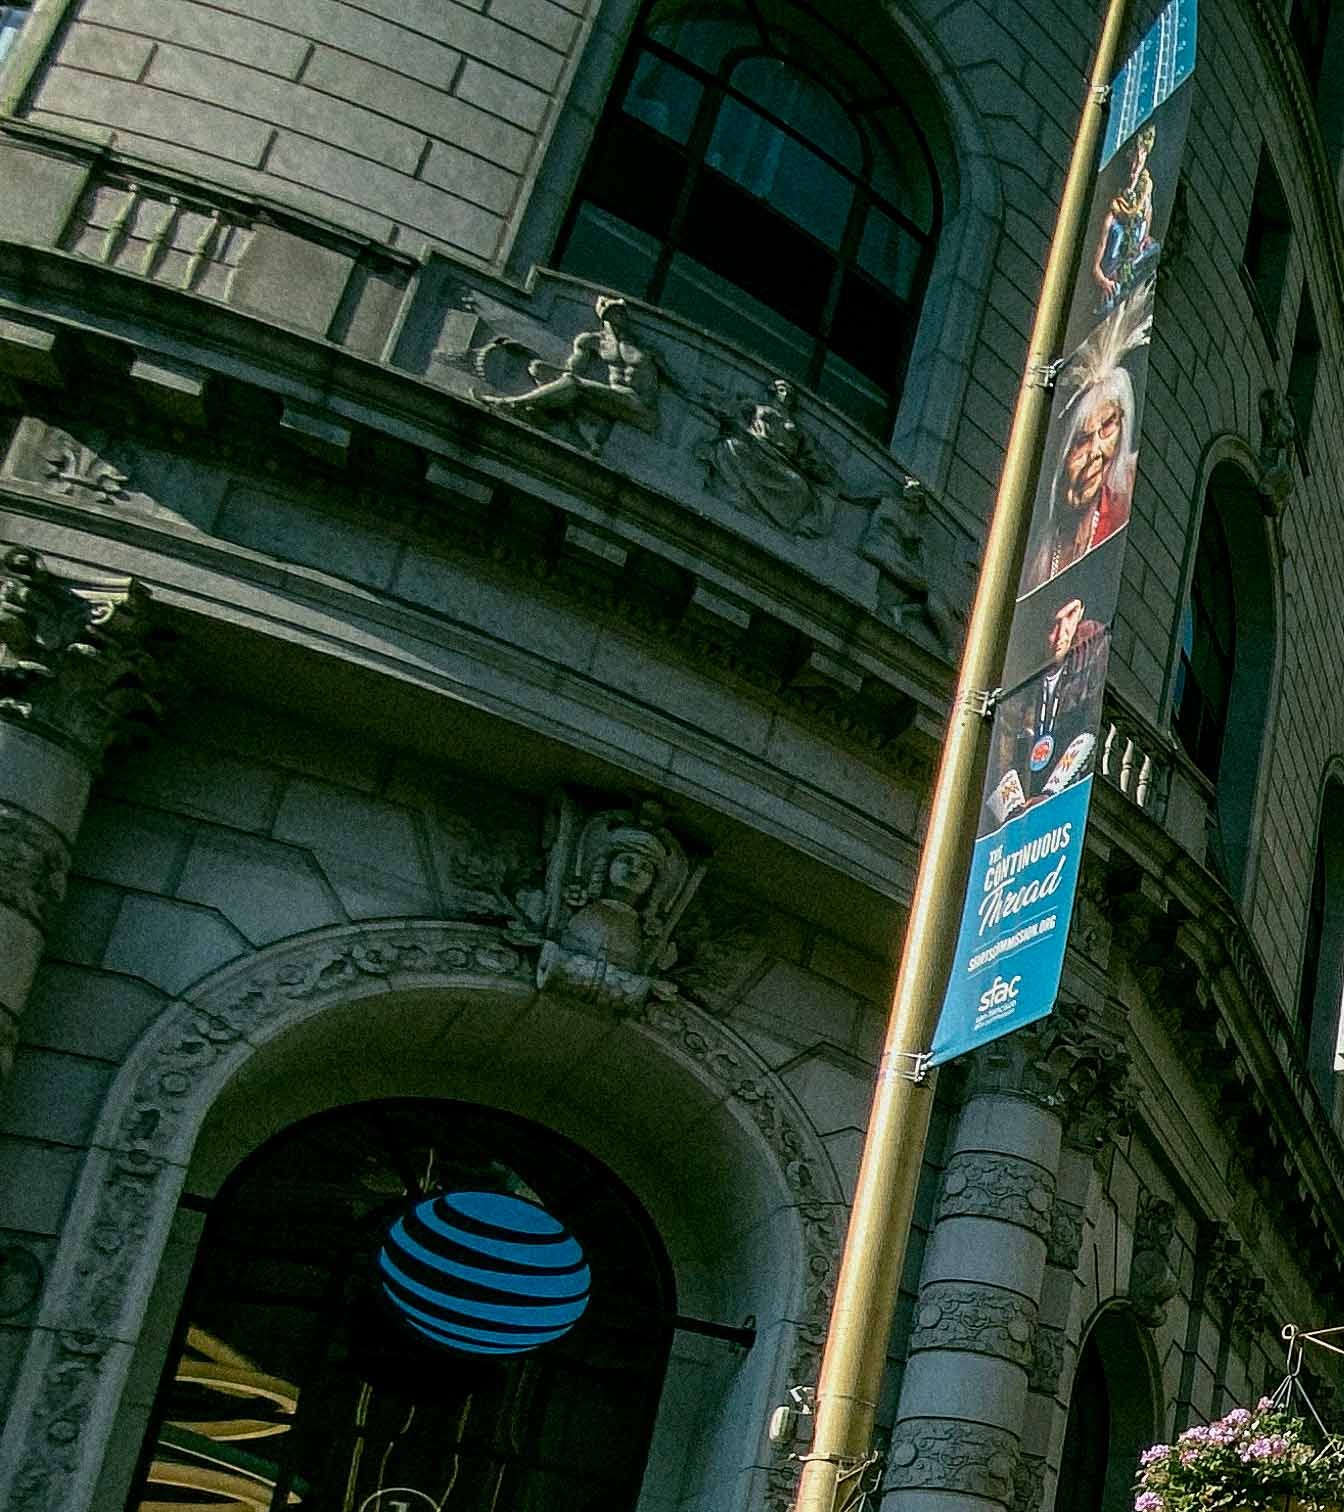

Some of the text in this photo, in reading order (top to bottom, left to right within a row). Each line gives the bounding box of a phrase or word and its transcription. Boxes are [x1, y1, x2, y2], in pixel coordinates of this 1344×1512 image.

[983, 822, 1072, 893] CONTINUOUS
[989, 844, 1004, 866] THE
[977, 854, 1067, 937] Thread
[977, 975, 1022, 1012] sfac
